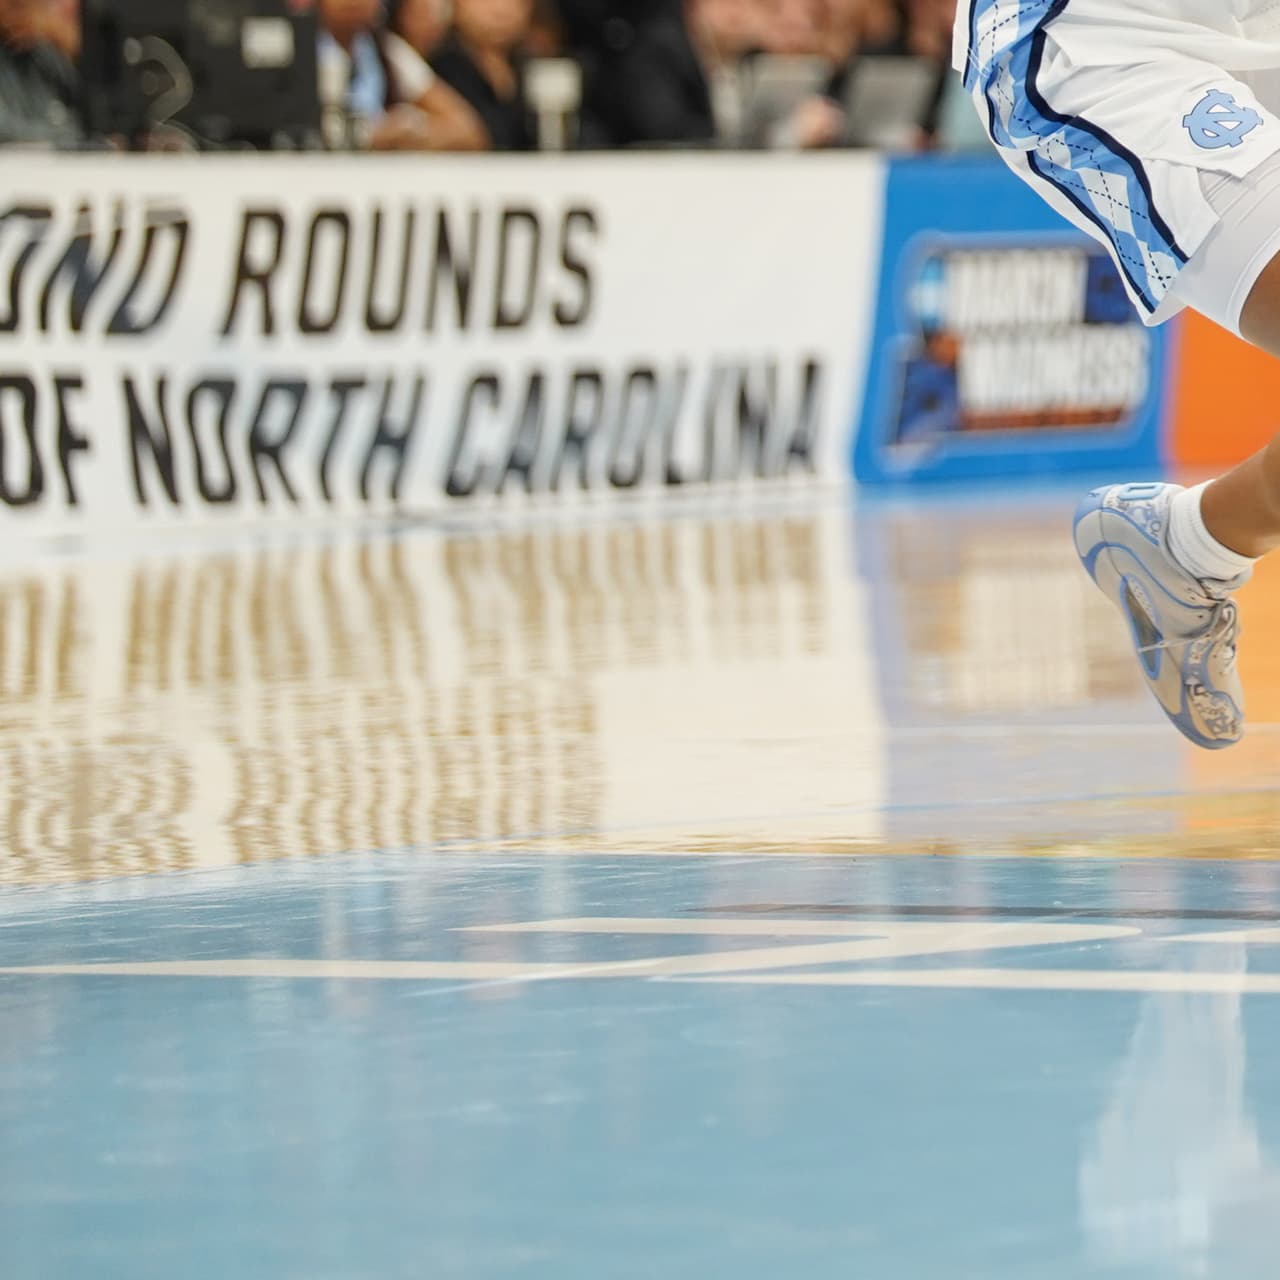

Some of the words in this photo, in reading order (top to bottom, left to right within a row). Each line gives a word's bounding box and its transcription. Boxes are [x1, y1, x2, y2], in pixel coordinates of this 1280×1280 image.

[221, 207, 601, 335] ROUNDS
[121, 375, 425, 505] NORTH
[444, 358, 821, 498] CAROLINA
